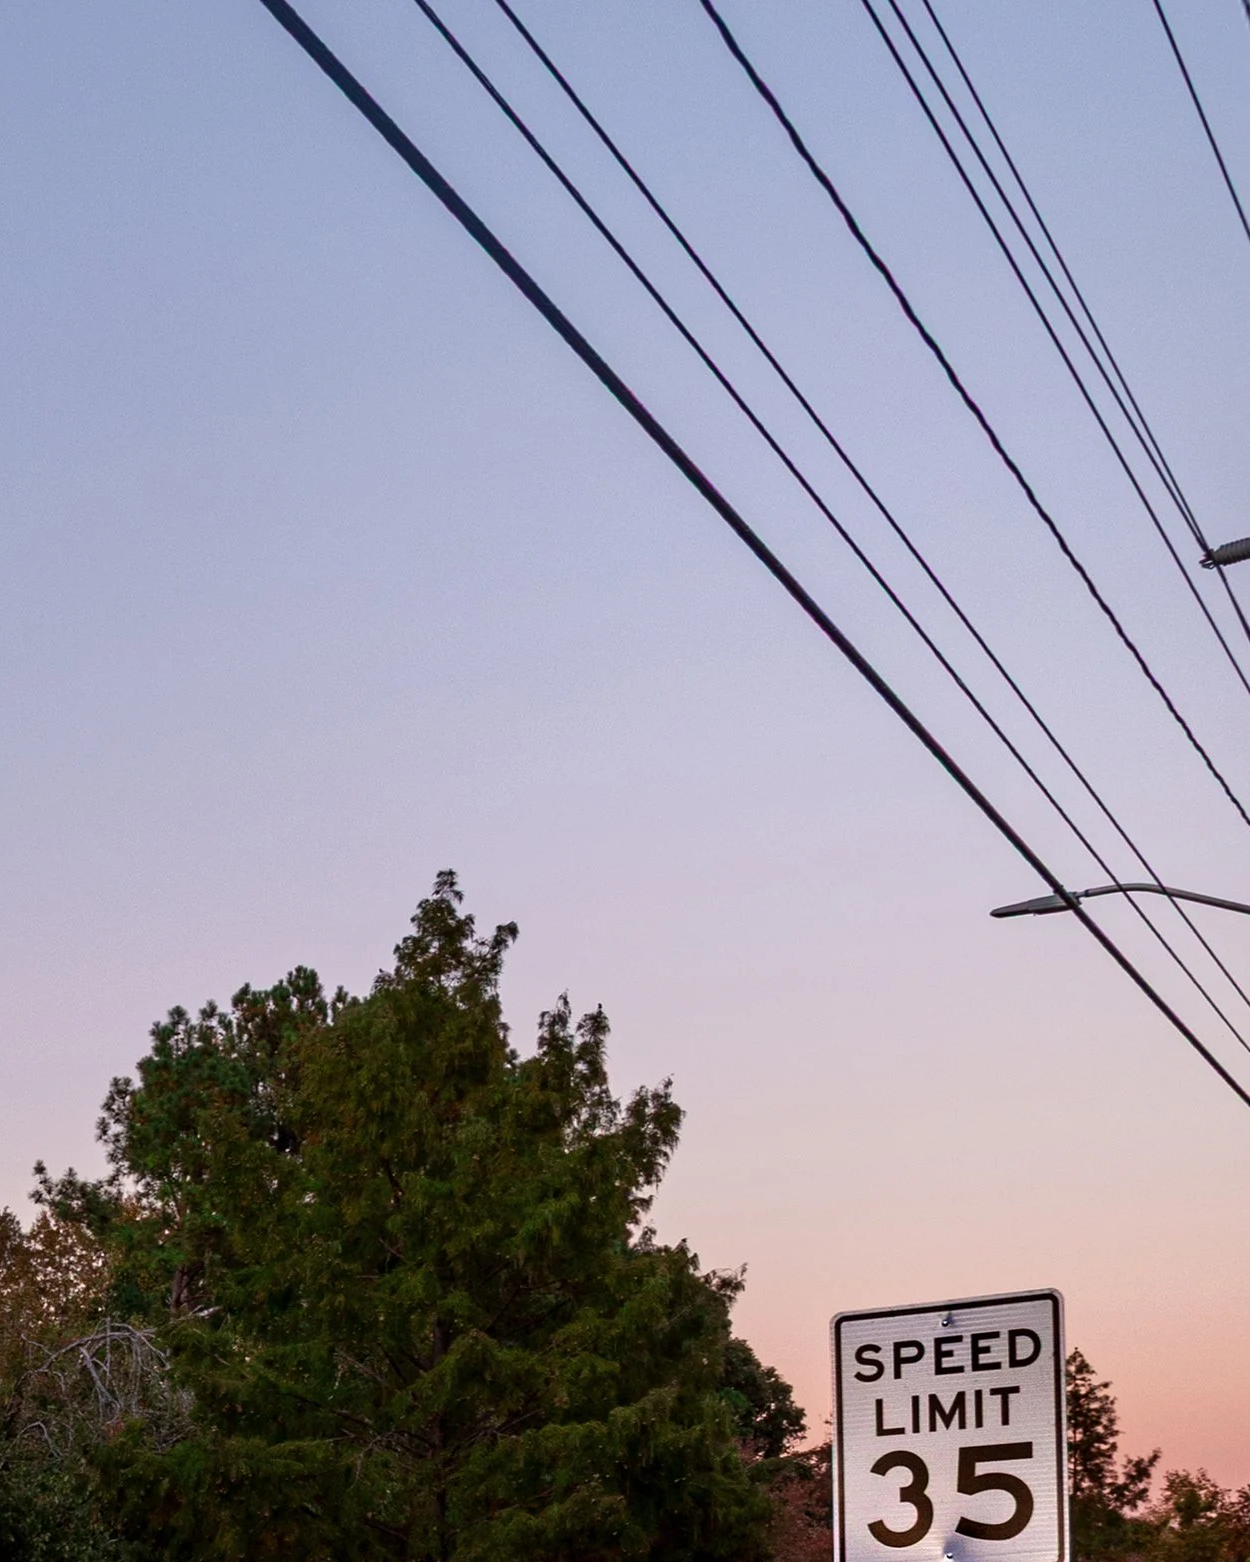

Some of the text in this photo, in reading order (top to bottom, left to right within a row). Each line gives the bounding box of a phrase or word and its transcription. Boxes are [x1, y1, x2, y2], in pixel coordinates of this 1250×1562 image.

[854, 1328, 1042, 1382] SPEED
[876, 1386, 1020, 1436] LIMIT
[867, 1441, 1034, 1548] 35
